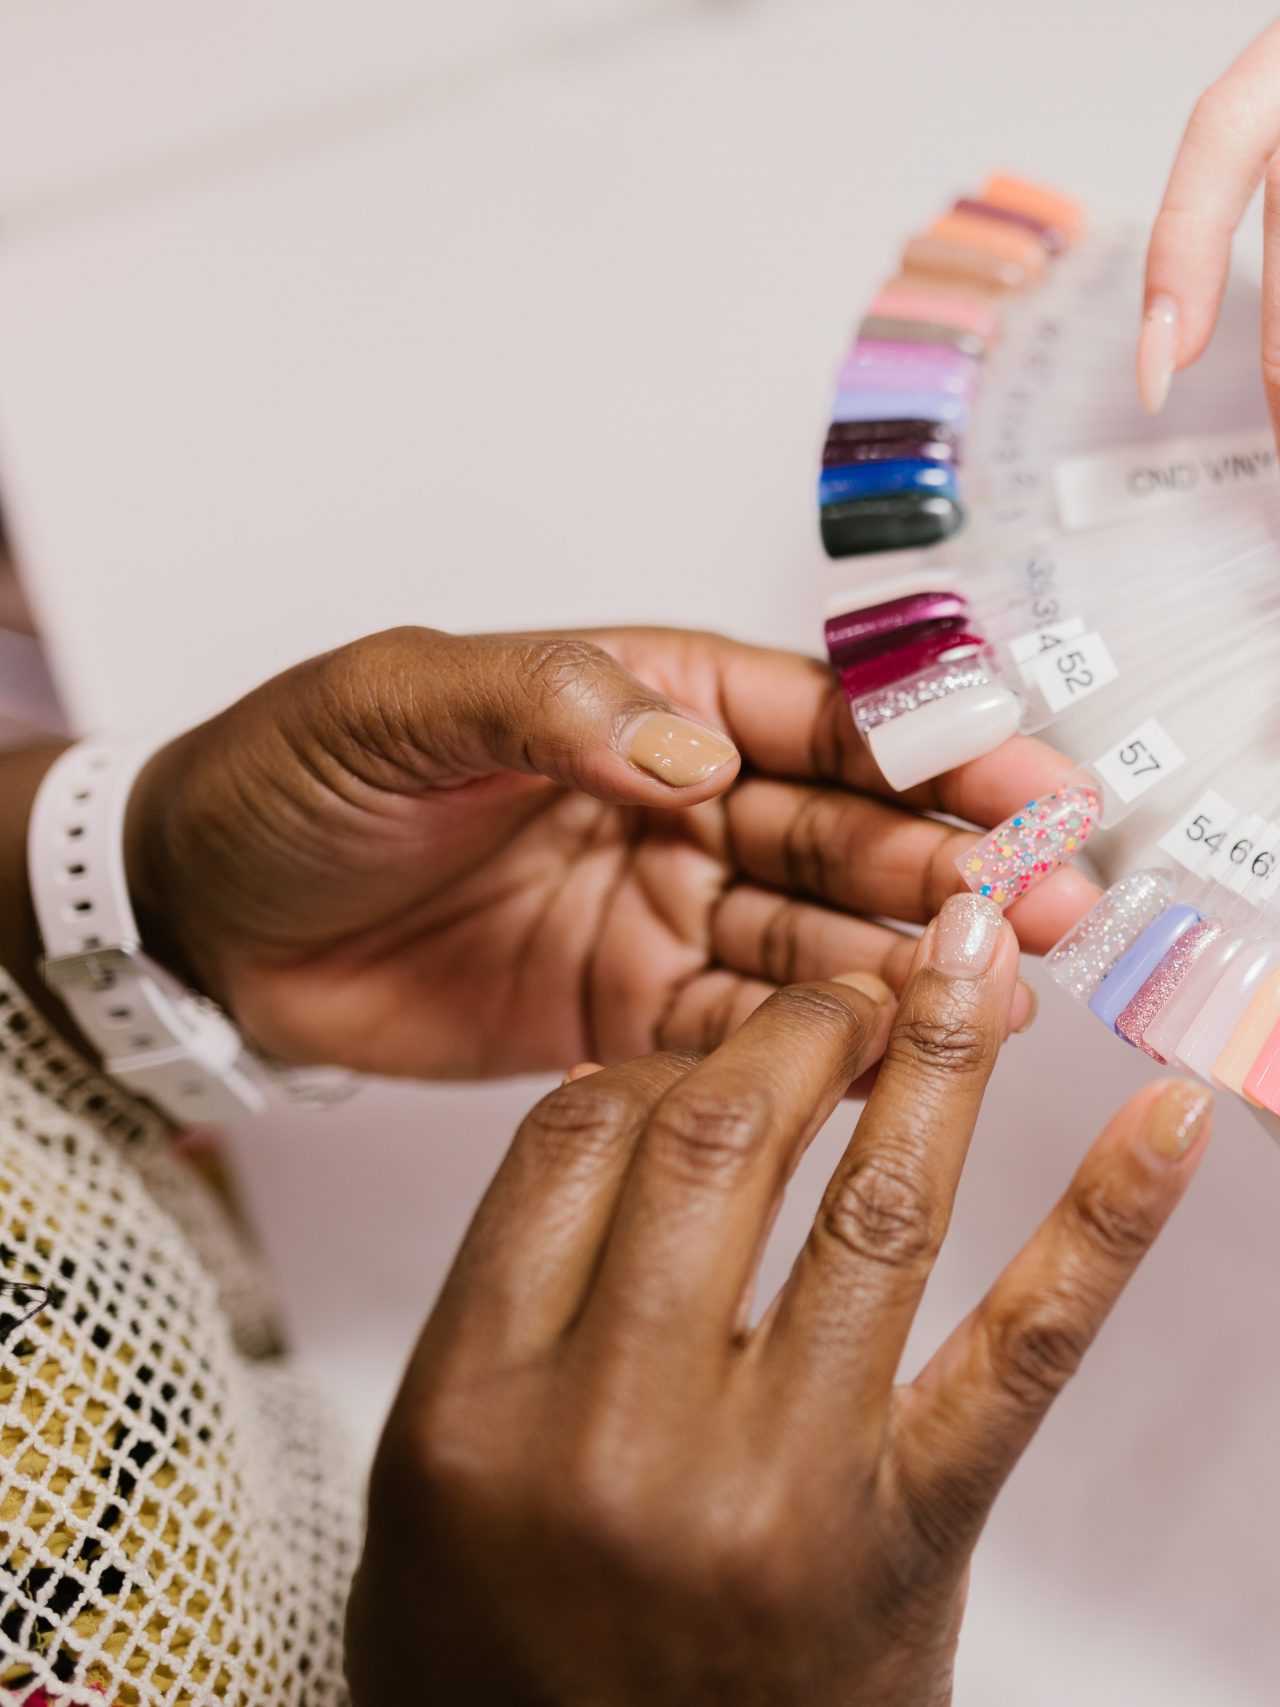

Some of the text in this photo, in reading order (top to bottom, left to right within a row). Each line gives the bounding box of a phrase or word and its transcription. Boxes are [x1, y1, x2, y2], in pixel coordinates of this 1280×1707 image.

[1056, 650, 1094, 695] 52
[1119, 740, 1161, 777] 57
[1185, 814, 1227, 856] 54
